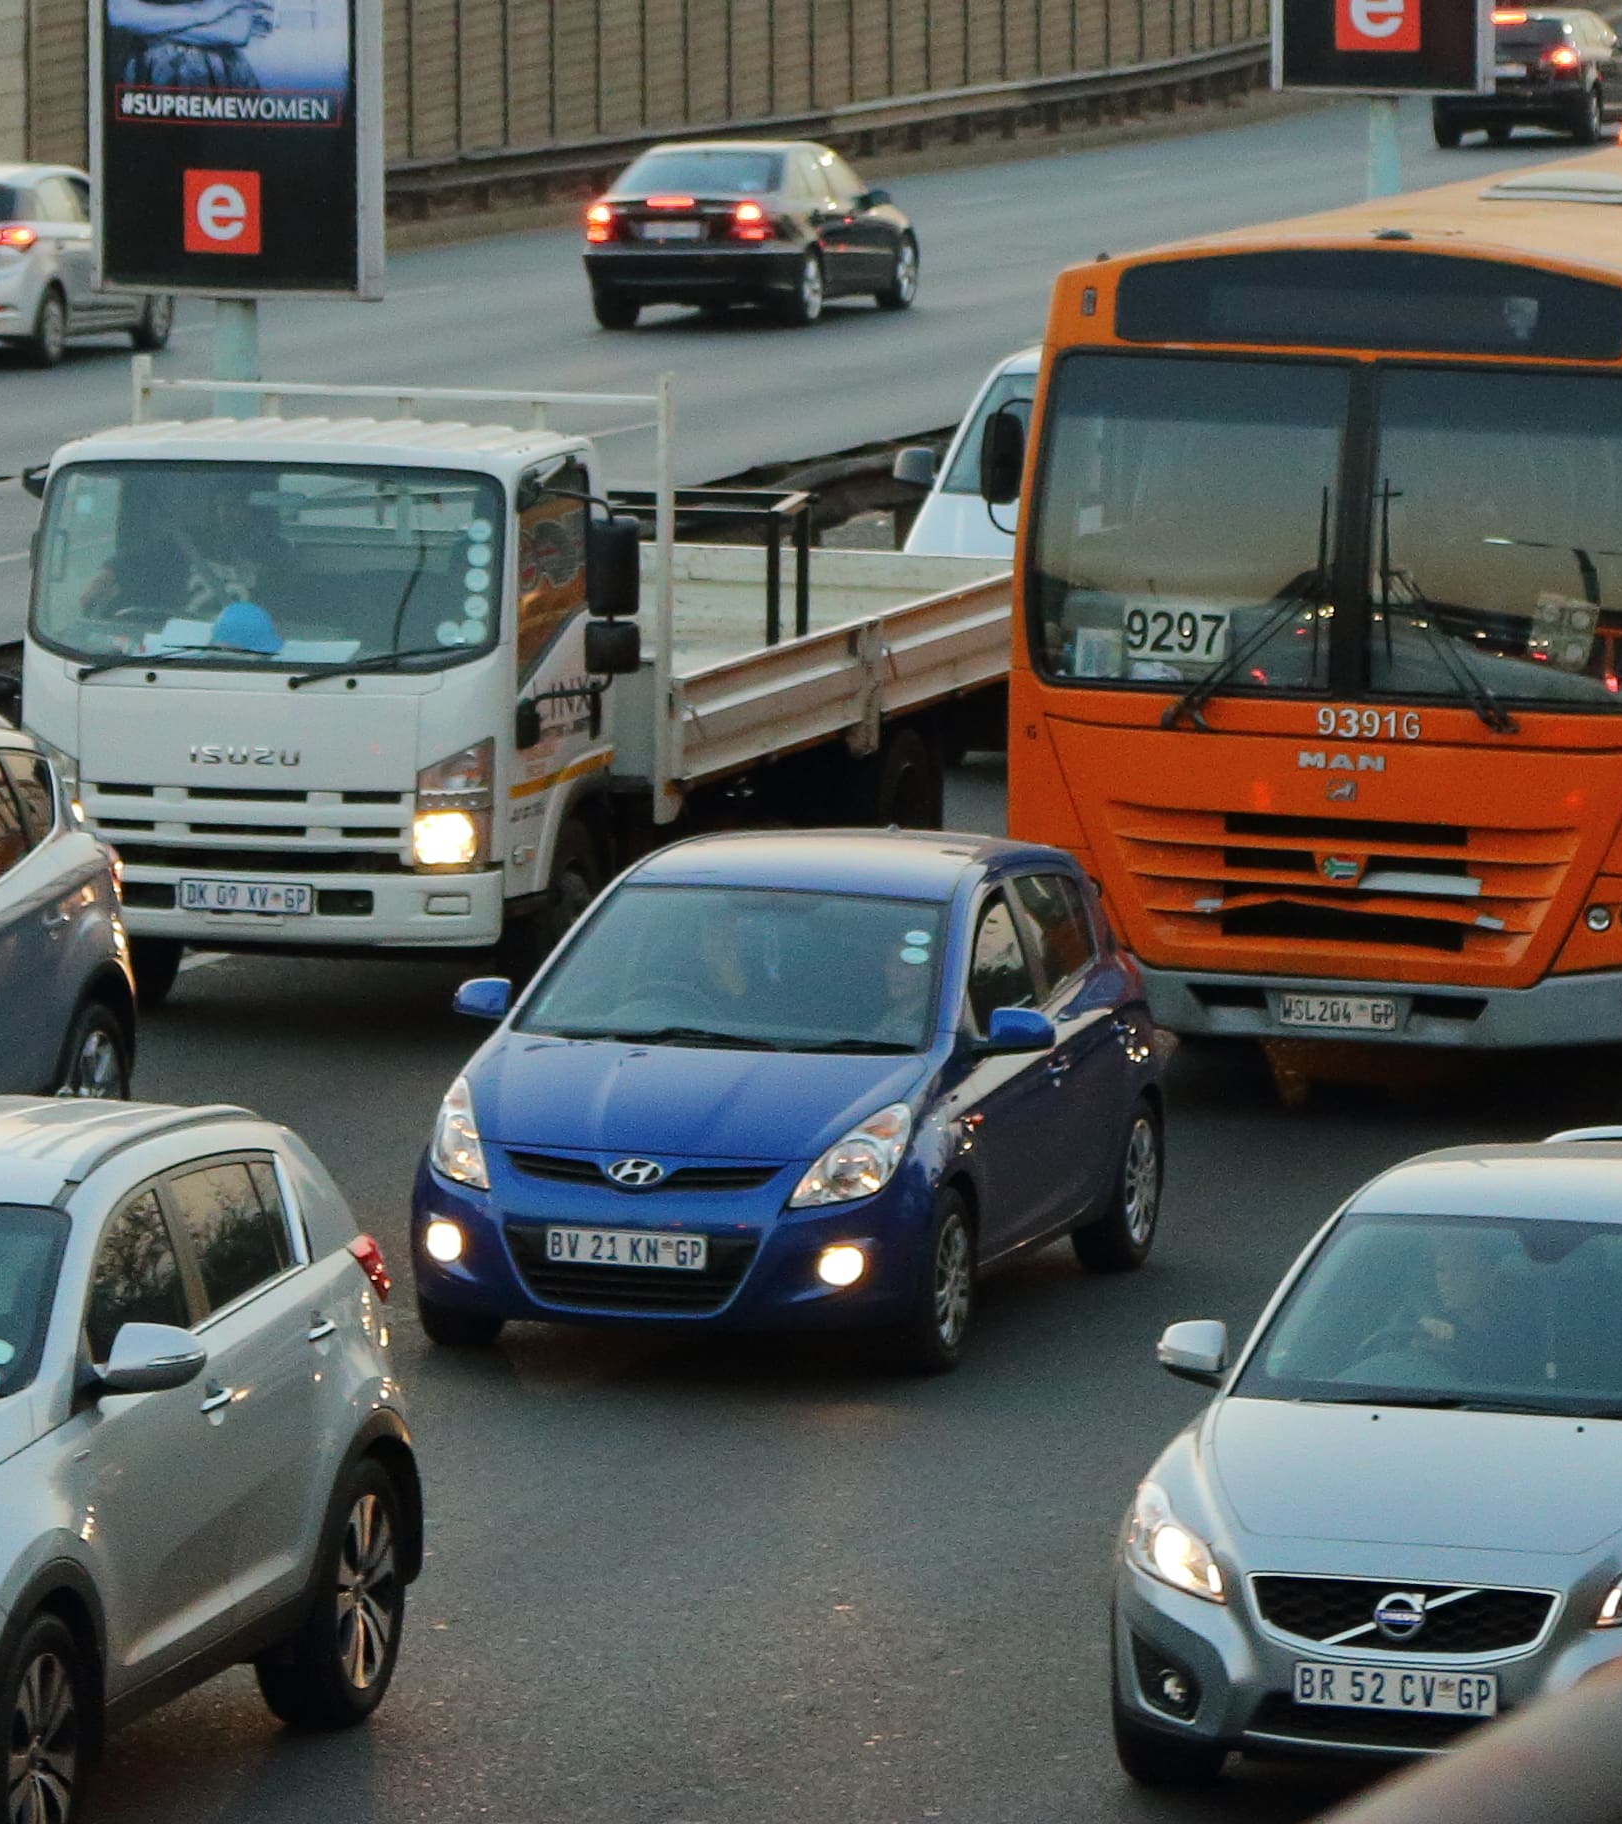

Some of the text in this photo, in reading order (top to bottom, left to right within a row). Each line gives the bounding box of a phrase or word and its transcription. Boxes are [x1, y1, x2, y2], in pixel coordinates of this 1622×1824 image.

[121, 92, 329, 121] #SUPREMEWOMEN
[196, 183, 247, 242] e
[1127, 608, 1226, 656] 9297
[1317, 706, 1421, 740] 9391G
[189, 745, 301, 767] ISUZU
[1297, 750, 1386, 773] MAN
[186, 882, 208, 906] DK
[283, 888, 307, 910] GP
[1370, 1002, 1394, 1025] GP
[550, 1231, 703, 1267] BV 21 KN GP
[1299, 1667, 1492, 1711] BR 52 CV GP
